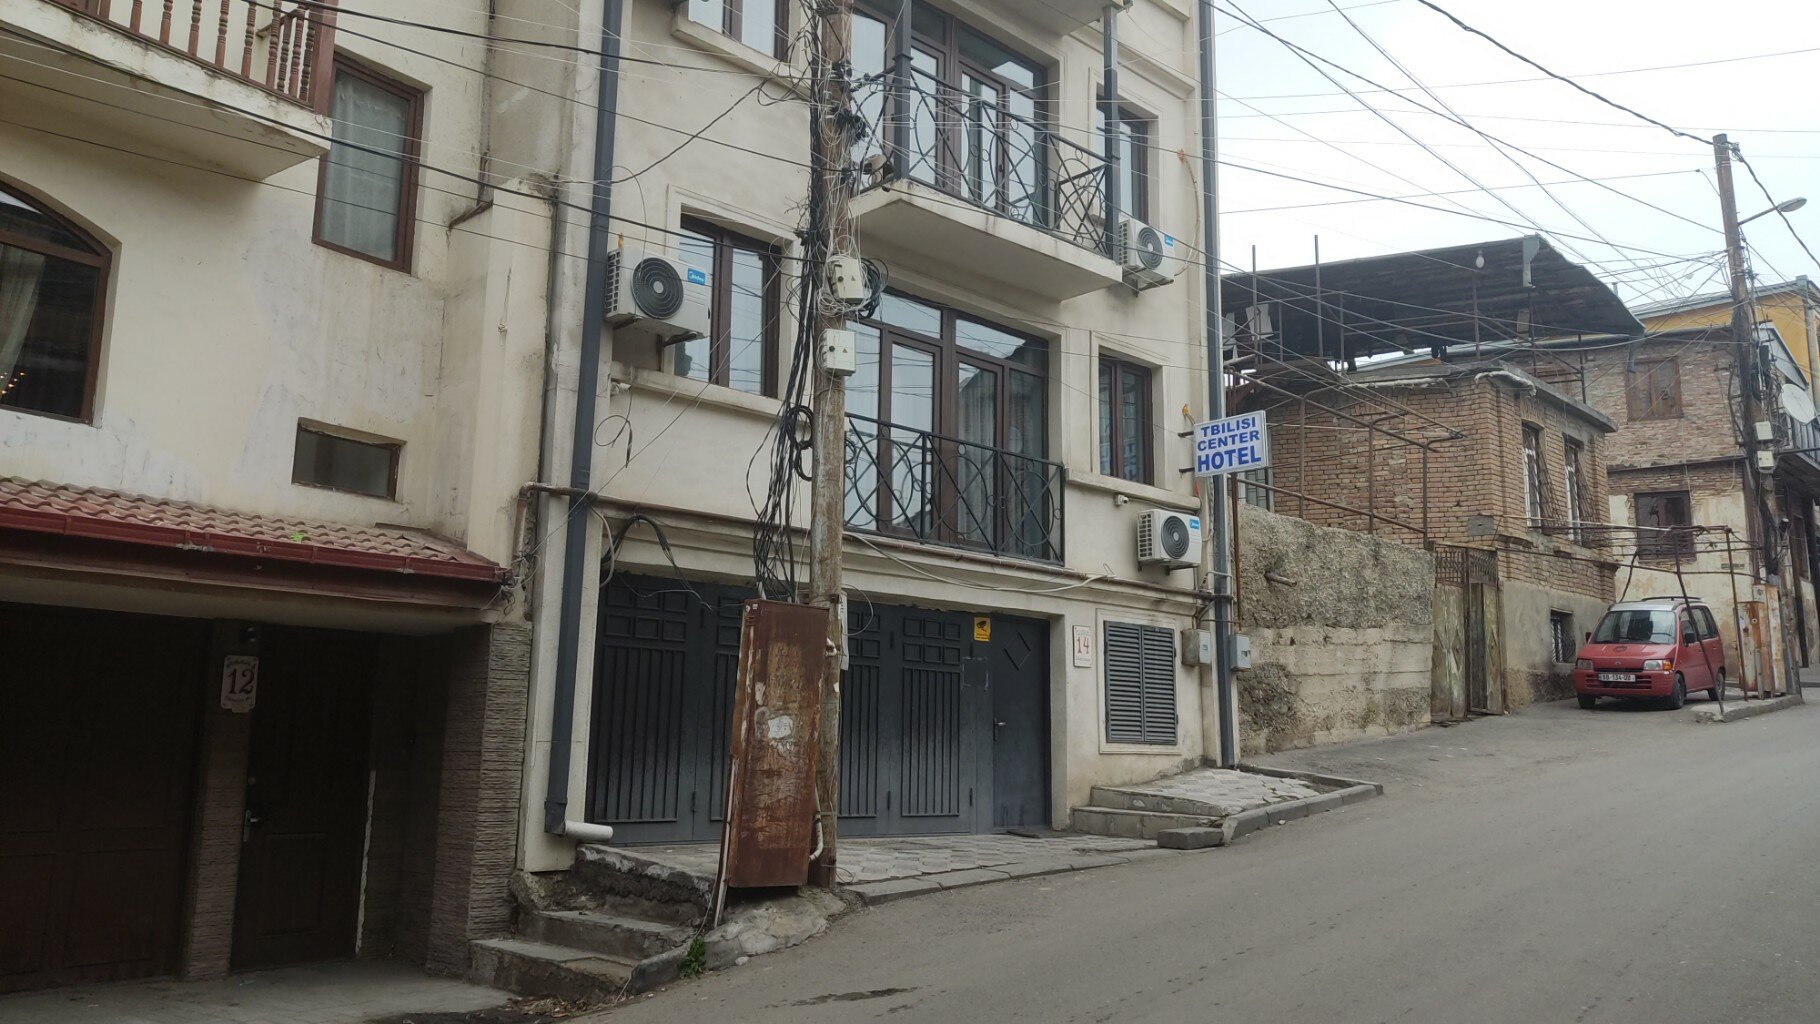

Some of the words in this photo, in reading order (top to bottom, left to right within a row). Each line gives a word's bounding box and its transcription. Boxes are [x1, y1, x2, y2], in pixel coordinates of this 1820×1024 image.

[1201, 417, 1256, 437] TBILISI
[1197, 430, 1260, 451] CENTER
[1197, 446, 1261, 472] HOTEL
[1076, 637, 1090, 654] 14
[228, 669, 254, 694] 12
